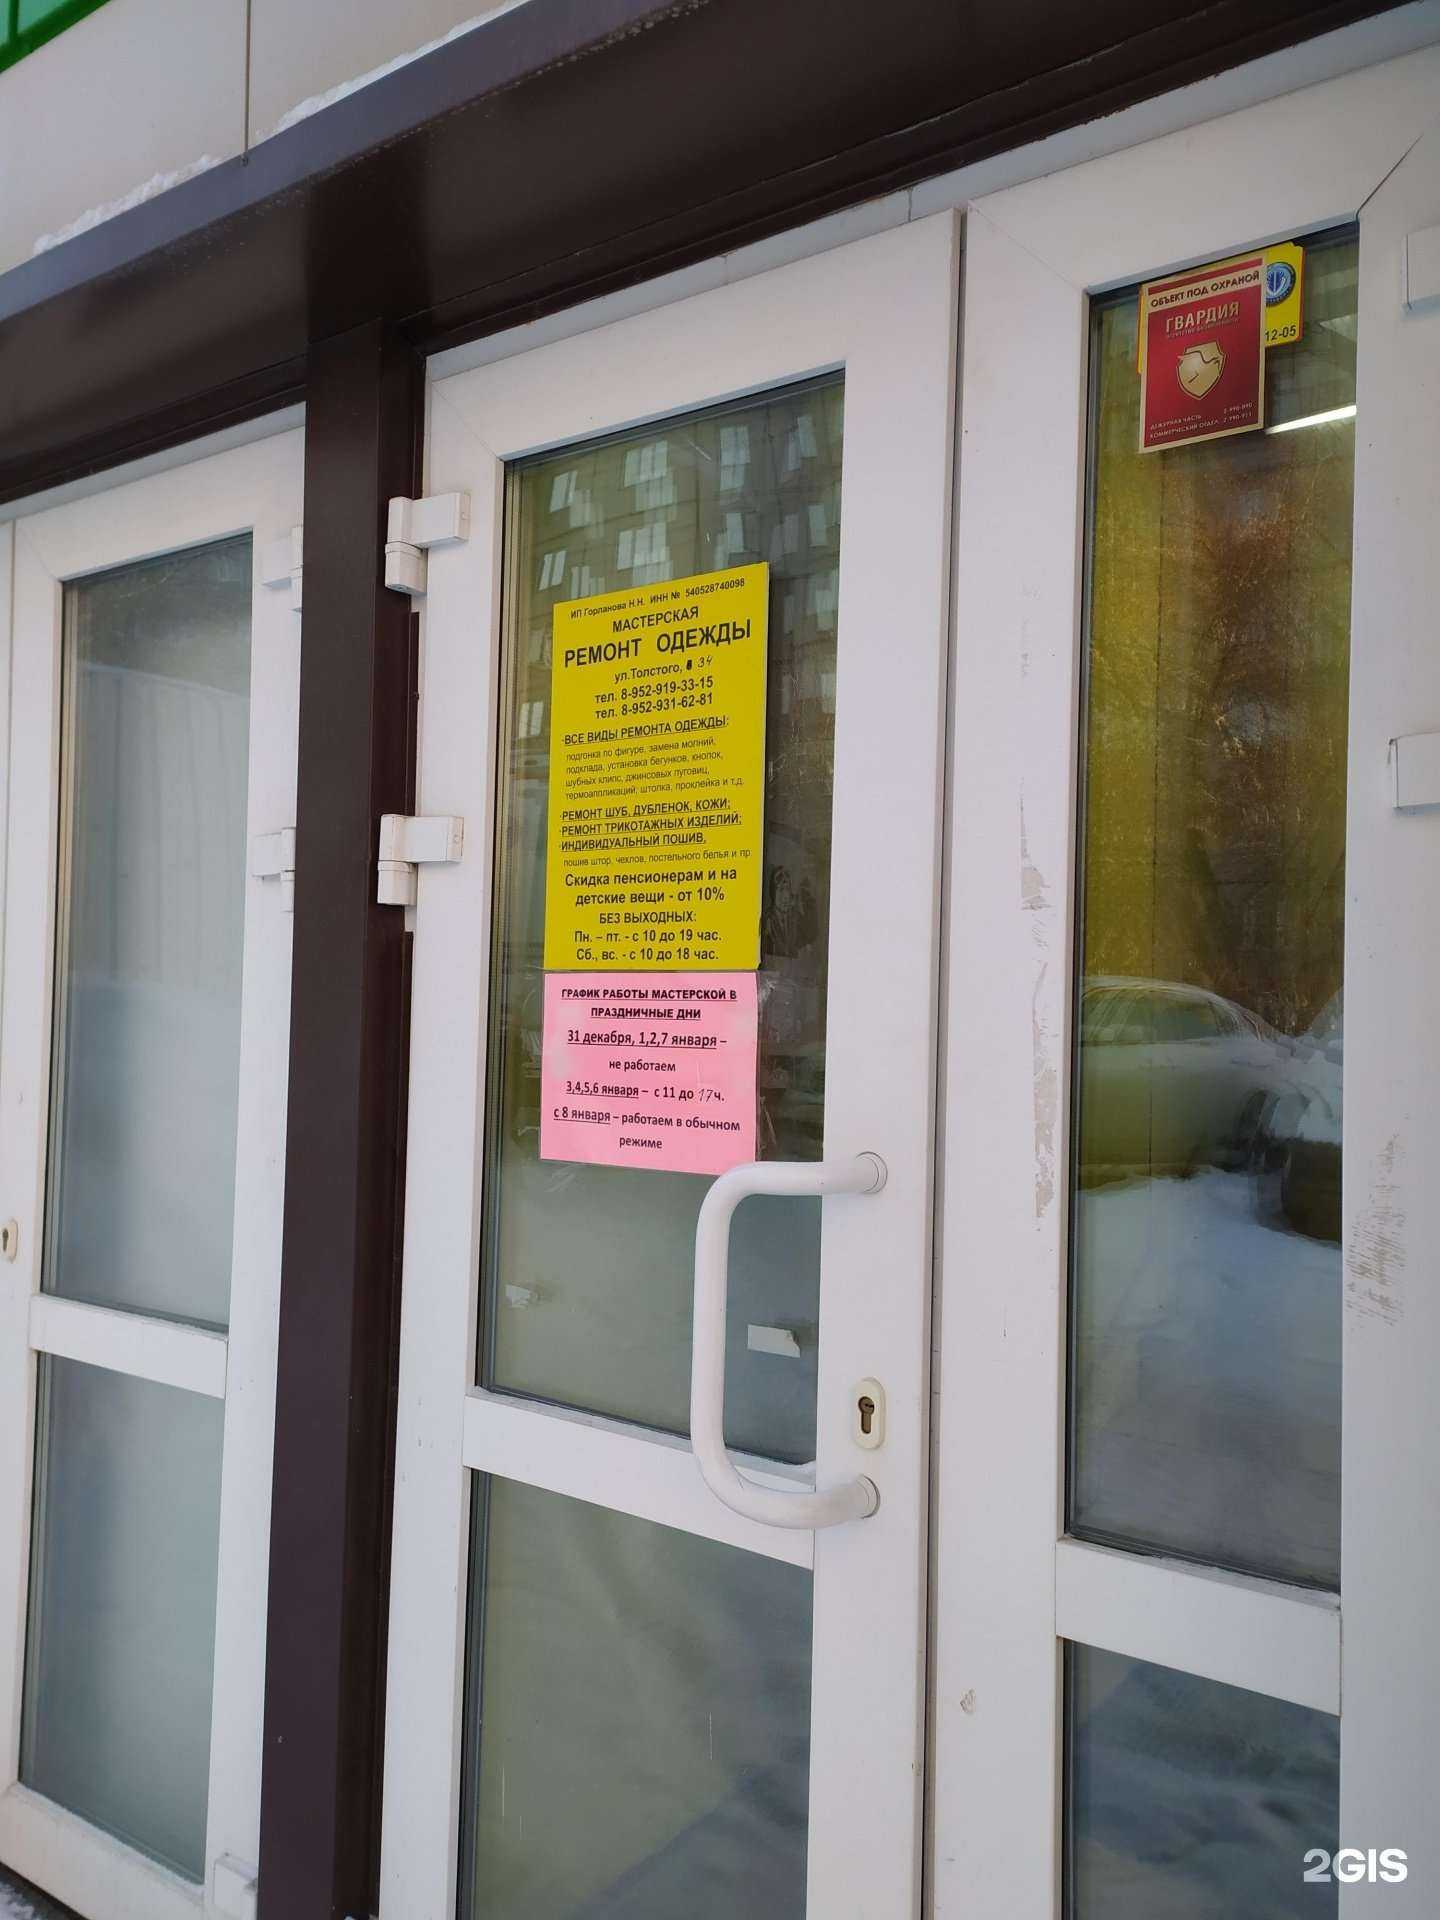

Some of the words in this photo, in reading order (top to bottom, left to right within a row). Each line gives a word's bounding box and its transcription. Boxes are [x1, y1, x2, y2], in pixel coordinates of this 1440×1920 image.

[1151, 293, 1185, 308] ОБЪЕКТ
[1187, 289, 1209, 299] ПОД
[1210, 270, 1259, 291] ОХРАНОЙ
[1166, 301, 1239, 333] ГВАРДИЯ
[570, 610, 582, 619] ИП
[629, 598, 645, 608] Н.Н.
[650, 592, 668, 605] ИНН
[671, 591, 680, 600] №
[686, 578, 745, 597] 540528740098
[612, 606, 699, 632] МАСТЕРСКАЯ
[564, 637, 642, 668] РЕМОНТ
[656, 618, 751, 655] ОДЕЖДЫ
[595, 692, 617, 704] тел.
[621, 675, 714, 700] 8-952-919-33-15
[595, 708, 618, 719] тел.
[621, 692, 713, 716] 8-952-931-62-81
[587, 728, 618, 742] ВИДЫ
[621, 722, 672, 739] РЕМОНТА
[674, 715, 730, 733] ОДЕЖДЫ:
[566, 750, 601, 762] подгонка
[603, 749, 613, 758] по
[649, 741, 679, 753] замена
[607, 758, 648, 772] установка
[565, 776, 597, 790] шубных
[625, 769, 672, 783] джинсовых
[674, 765, 710, 779] пуговиц,
[675, 777, 720, 792] проклейка
[722, 779, 729, 787] и
[605, 806, 631, 818] ШУБ,
[695, 798, 730, 811] КОЖИ;
[605, 816, 684, 833] ТРИКОТАЖНЫХ
[687, 810, 742, 828] ИЗДЕЛИЙ;
[561, 832, 660, 852] ИНДИВИДУАЛЬНЫЙ
[563, 858, 589, 868] пошив
[648, 851, 701, 864] постельного
[703, 848, 729, 859] белья
[731, 850, 737, 858] и
[565, 873, 610, 888] Скидка
[613, 869, 704, 885] пенсионерам
[707, 869, 716, 880] и
[720, 868, 737, 880] на
[575, 892, 626, 907] детские
[629, 890, 665, 904] вещи
[677, 890, 692, 902] от
[697, 886, 725, 901] 10%
[599, 912, 621, 924] БЕЗ
[623, 910, 697, 925] ВЫХОДНЫХ:
[574, 930, 593, 942] Пн.
[606, 932, 621, 942] пт.
[632, 932, 639, 942] с
[643, 929, 656, 942] 10
[659, 931, 676, 943] до
[679, 928, 693, 941] 19
[696, 930, 722, 941] час.
[576, 948, 598, 962] Сб.,
[601, 950, 618, 960] вс.
[629, 950, 637, 960] с
[640, 947, 653, 960] 10
[656, 949, 673, 962] до
[676, 946, 690, 960] 18
[693, 949, 719, 960] час.
[561, 988, 600, 999] ГРАФИК
[603, 988, 649, 999] РАБОТЫ
[651, 988, 727, 1000] МАСТЕРСКОЙ
[730, 989, 737, 999] В
[591, 1006, 673, 1018] ПРАЗДНИЧНЫЕ
[676, 1008, 701, 1020] ДНИ
[567, 1029, 580, 1042] 31
[583, 1030, 635, 1045] декабря,
[638, 1031, 668, 1047] 1,2,7
[671, 1036, 717, 1048] января
[609, 1060, 622, 1070] не
[624, 1058, 676, 1073] работаем
[566, 1080, 599, 1095] 3,4,5,6
[601, 1084, 639, 1096] января
[654, 1088, 660, 1098] с
[663, 1086, 676, 1099] 11
[678, 1088, 694, 1100] до
[553, 1107, 560, 1118] с
[562, 1106, 569, 1119] 8
[571, 1109, 611, 1123] января
[621, 1113, 673, 1127] работаем
[676, 1118, 682, 1127] в
[685, 1116, 740, 1131] обычном
[619, 1136, 663, 1149] режиме
